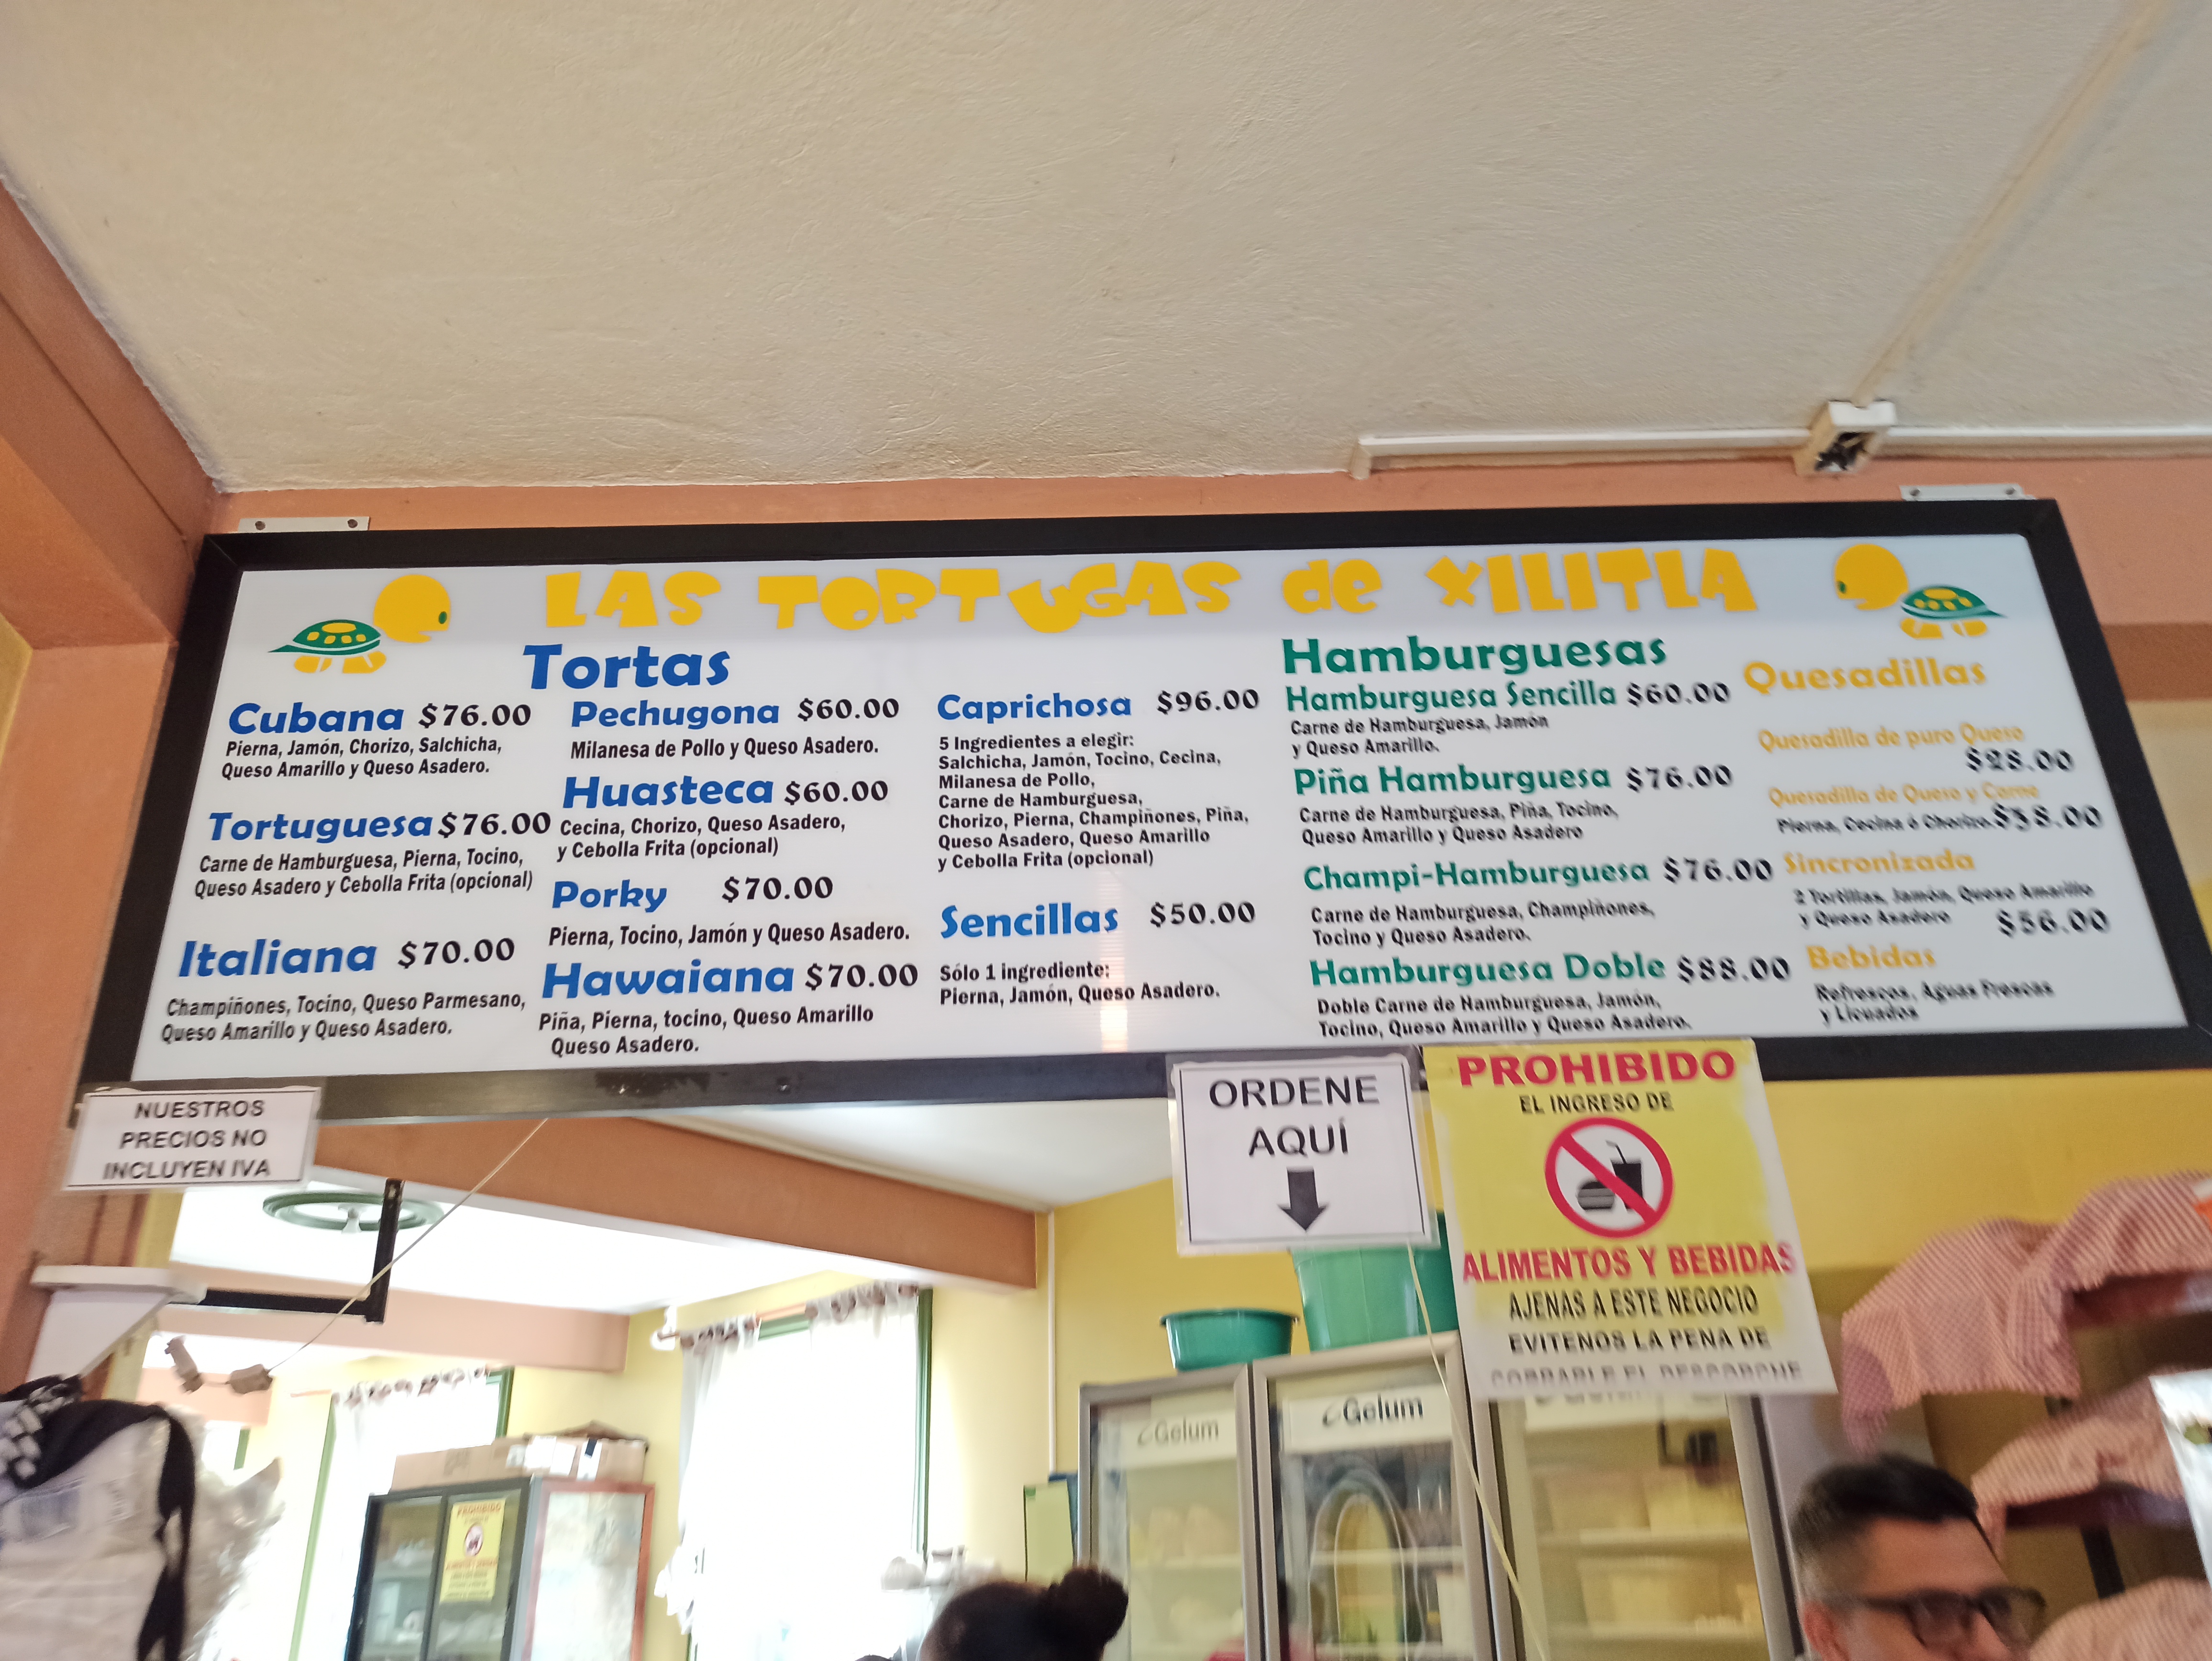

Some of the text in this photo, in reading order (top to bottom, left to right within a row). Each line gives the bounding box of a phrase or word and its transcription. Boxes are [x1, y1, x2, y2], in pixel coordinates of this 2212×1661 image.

[546, 571, 721, 627] LAS
[758, 561, 1241, 633] TORTUGAS
[1283, 560, 1382, 613] de
[523, 644, 730, 689] Tortas
[1283, 635, 1666, 675] Hamburguesas
[1744, 658, 1985, 694] Quesadillas
[938, 689, 1259, 722] Caprichosa $96.00
[1286, 680, 1729, 712] Hamburguesa Sencilla $60.00
[229, 702, 531, 734] Cubana $76.00
[572, 698, 899, 730] Pechugona $60.00
[1291, 714, 1548, 734] Carne de Hamburguesa, Jamón
[226, 736, 501, 758] Pierna, Jamón, Chorizo, Salchicha,
[571, 736, 878, 760] Milanesa de Pollo y Queso Asadero.
[940, 732, 1133, 753] 5 Ingredientes a elegir:
[222, 758, 489, 780] Queso Amarillo y Queso Asadero.
[939, 750, 1220, 770] Salchicha, Jamón, Tocino, Cecina,
[563, 775, 888, 808] Huasteca $60.00
[940, 772, 1095, 788] Milanesa de Pollo,
[1294, 764, 1731, 795] Piña Hamburguesa $76.00
[209, 812, 551, 843] Tortuguesa $76.00
[561, 814, 845, 838] Cecina, Chorizo, Queso Asadero,
[939, 807, 1248, 830] Chorizo, Pierna, Champiñones, Piña,
[200, 847, 522, 873] Carne de Hamburguesa, Pierna, Tocino,
[557, 837, 778, 863] y Cebolla Frita (opcional)
[938, 850, 1153, 873] y Cebolla Frita (opcional)
[1784, 850, 1974, 874] Sincronizada
[195, 870, 532, 899] Queso Asadero y Cebolla Frita (opcional)
[1305, 857, 1772, 892] Champi-Hamburguesa $76.00
[553, 876, 833, 911] Porky $70.00
[941, 902, 1255, 938] Sencillas $50.00
[549, 921, 909, 949] Pierna, Tocino, Jamón y Queso Asadero.
[179, 938, 514, 977] Italiana $70.00
[1310, 953, 1790, 986] Hamburguesa Doble $88.00
[1807, 945, 1935, 969] Bebidas
[542, 959, 918, 998] Hawaiana $70.00
[940, 962, 1109, 983] Sólo 1 ingrediente:
[167, 992, 525, 1019] Champiñones, Tocino, Queso Parmesano,
[940, 982, 1219, 1007] Pierna, Jamón, Queso Asadero.
[539, 1004, 873, 1033] Piña, Pierna, tocino, Queso Amarillo
[552, 1035, 698, 1058] Queso Asadero.
[1458, 1050, 1735, 1086] PROHIBIDO
[1210, 1076, 1379, 1107] ORDENE
[1519, 1092, 1674, 1113] EL INGRESO DE
[135, 1100, 264, 1118] NUESTROS
[121, 1129, 266, 1148] PRECIOS NO
[1249, 1117, 1349, 1157] AQUÍ
[103, 1160, 269, 1179] INCLUYEN IVA
[1462, 1243, 1796, 1283] ALIMENTOS Y BEBIDAS
[1510, 1286, 1758, 1319] AJENAS A ESTE NEGOCIO
[1509, 1326, 1771, 1354] EVITENOS LA PENA DE
